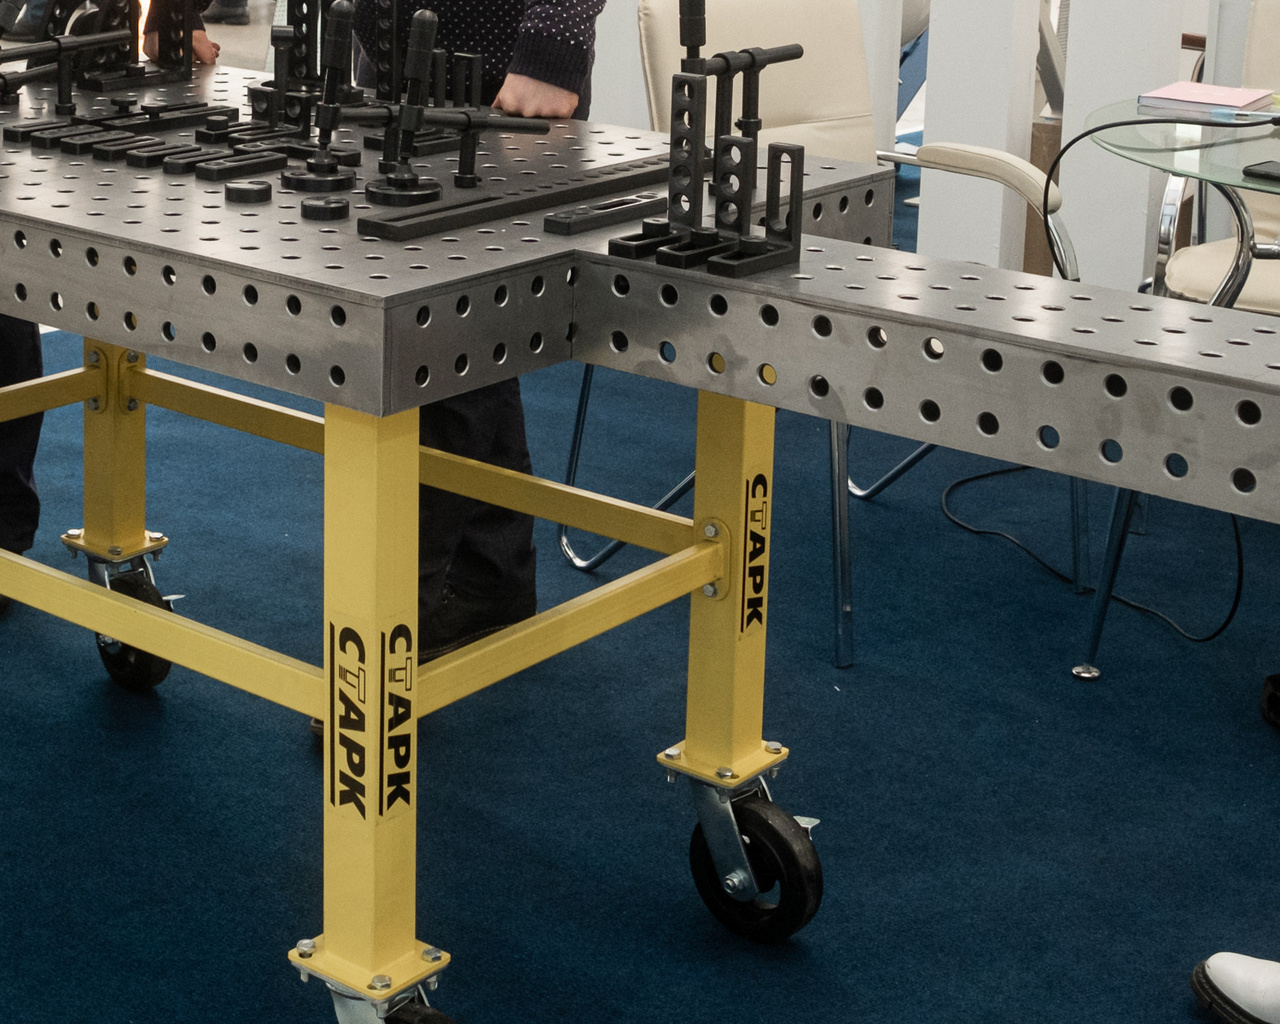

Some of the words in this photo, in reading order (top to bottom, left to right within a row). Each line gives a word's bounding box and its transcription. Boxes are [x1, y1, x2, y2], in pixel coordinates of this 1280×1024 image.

[746, 473, 768, 629] СТАРК
[339, 626, 366, 821] СТАРК
[387, 623, 413, 811] СТАРК
